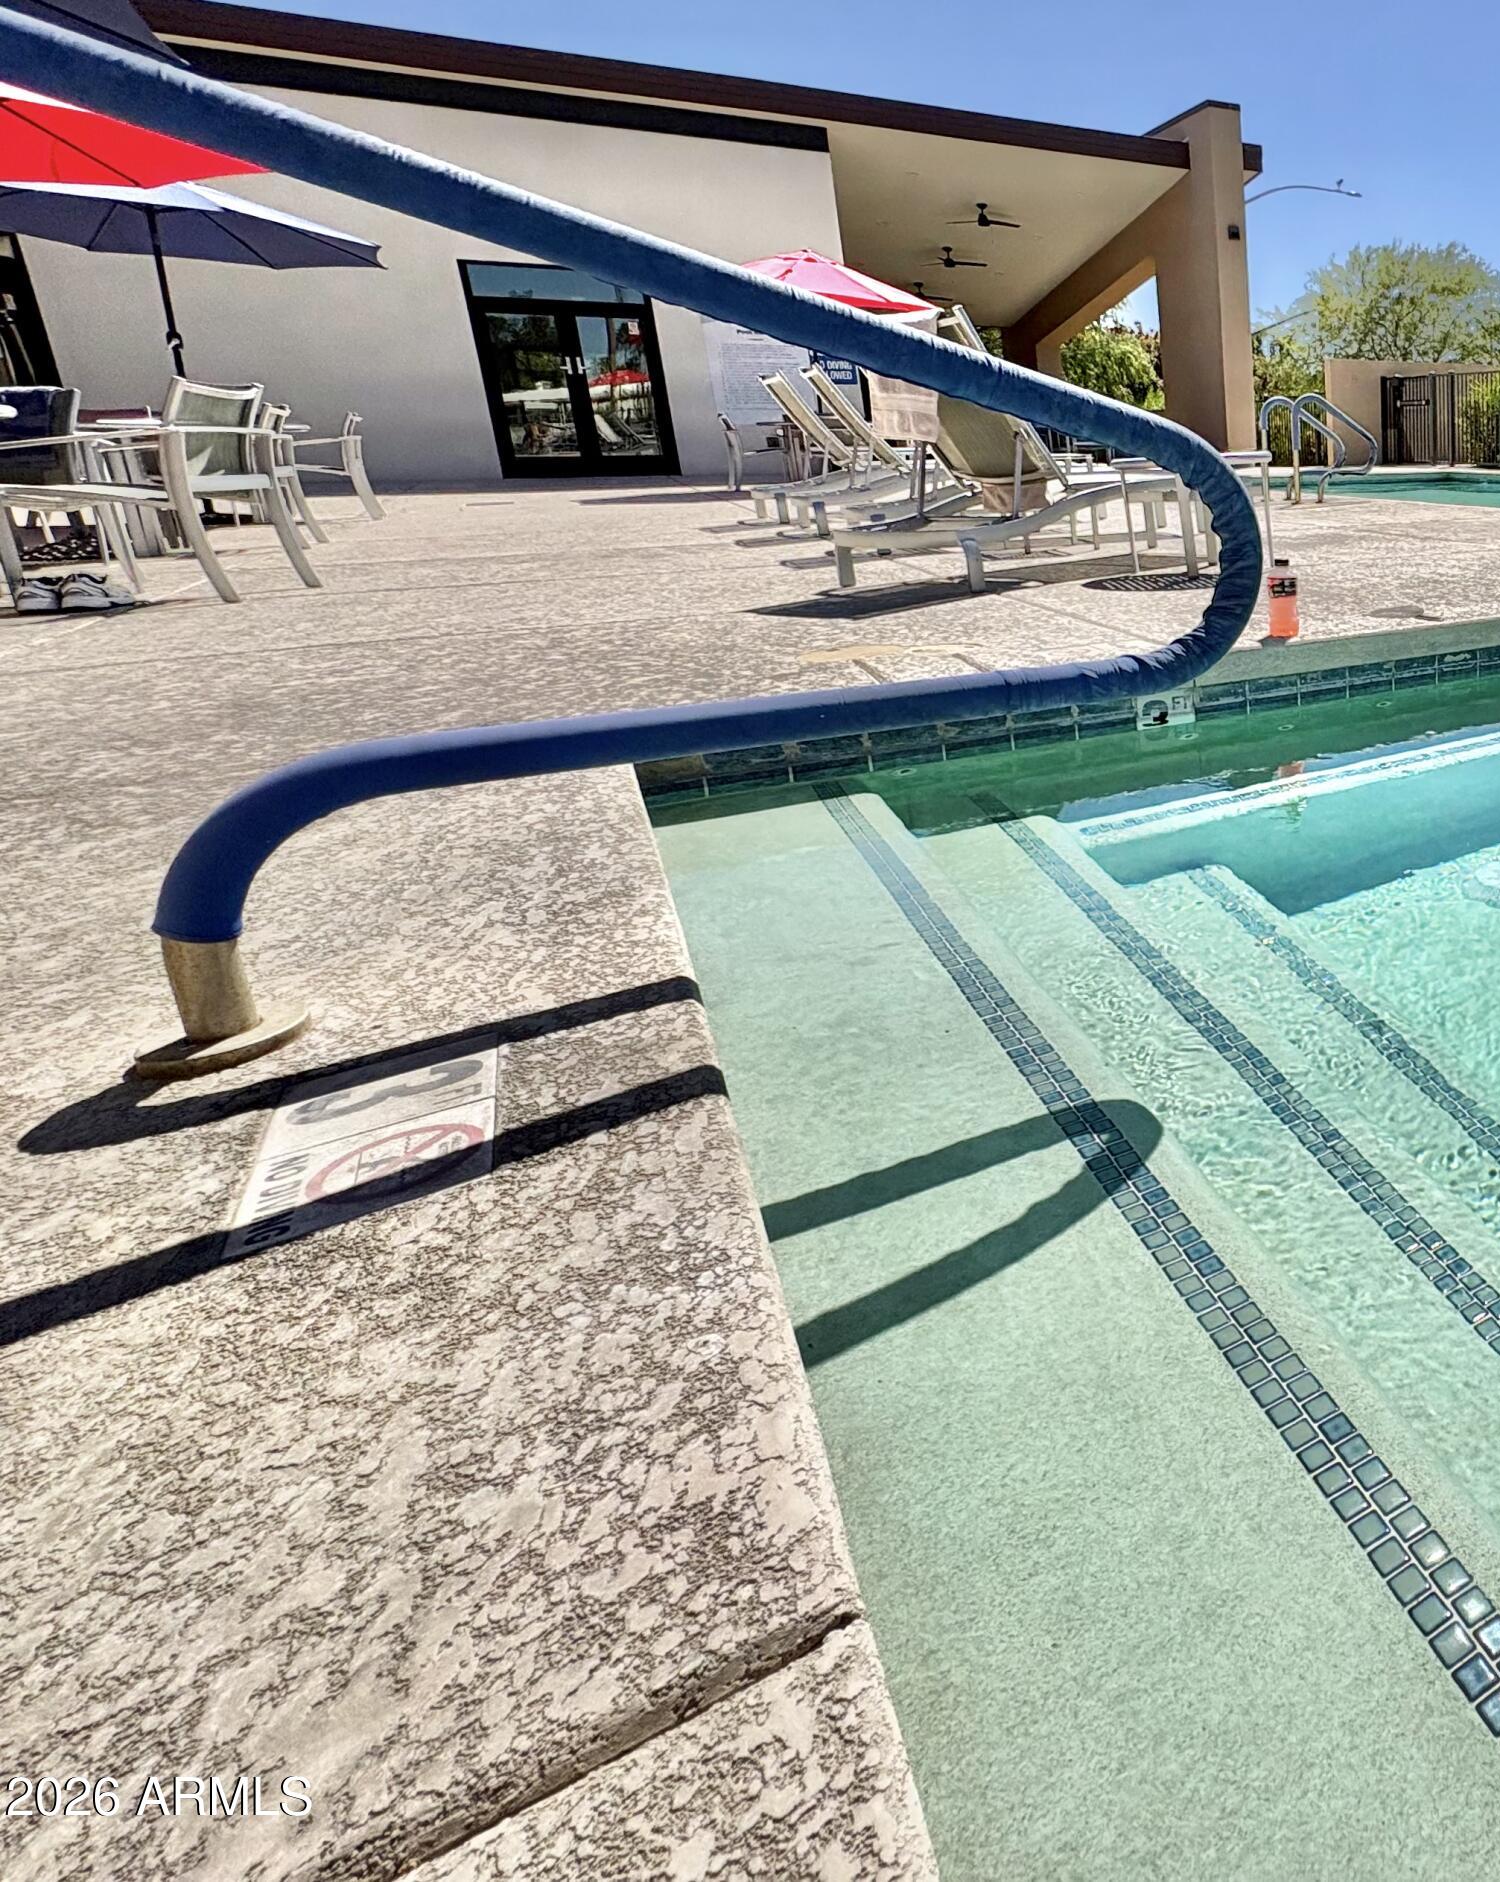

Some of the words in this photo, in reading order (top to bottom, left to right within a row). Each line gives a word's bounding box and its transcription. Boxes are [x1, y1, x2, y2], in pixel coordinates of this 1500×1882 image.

[286, 1059, 484, 1125] 3
[264, 1152, 311, 1182] NO
[243, 1179, 303, 1246] DIVING
